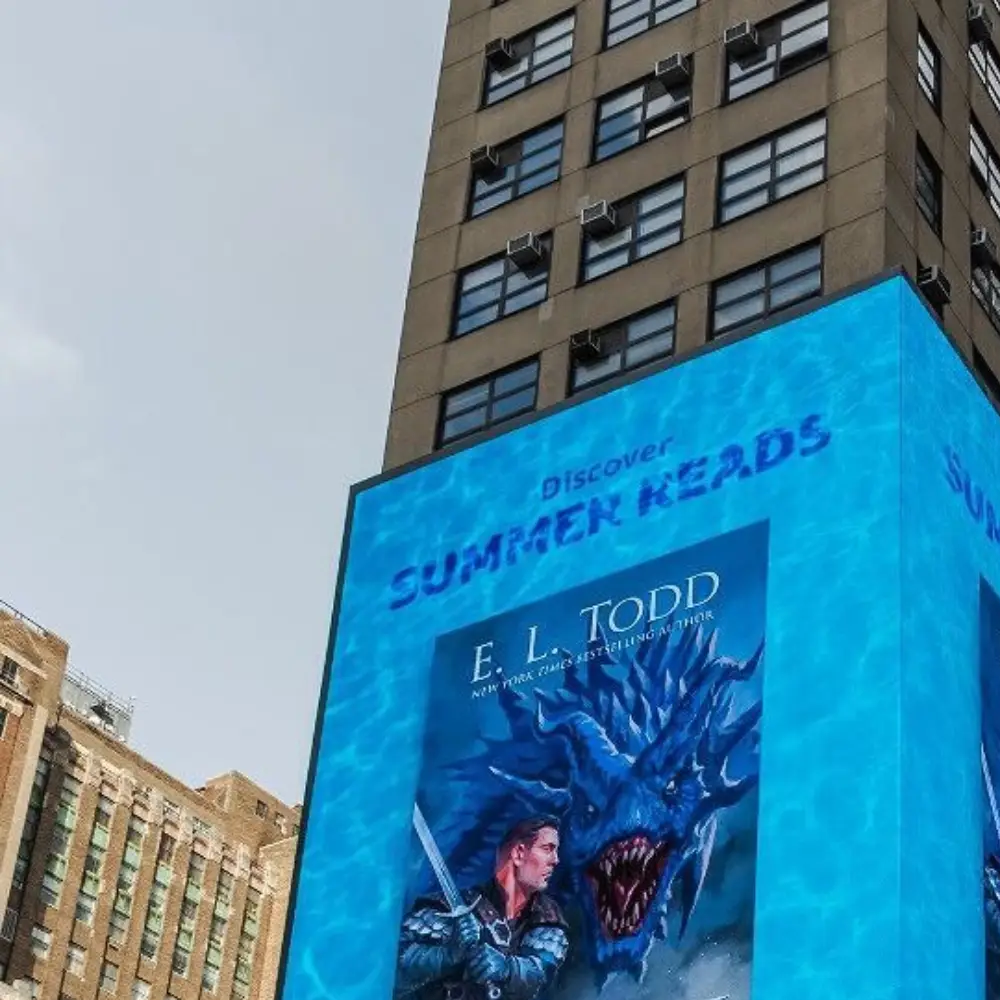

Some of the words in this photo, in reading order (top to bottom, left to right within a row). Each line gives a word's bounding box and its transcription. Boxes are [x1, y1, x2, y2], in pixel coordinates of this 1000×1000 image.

[388, 495, 622, 611] SUMMER
[638, 413, 831, 517] READS
[542, 435, 674, 501] Discover
[471, 641, 503, 684] E.
[527, 624, 559, 664] L.
[579, 571, 720, 643] TODD
[502, 668, 535, 690] YORK
[538, 656, 574, 677] TIMES
